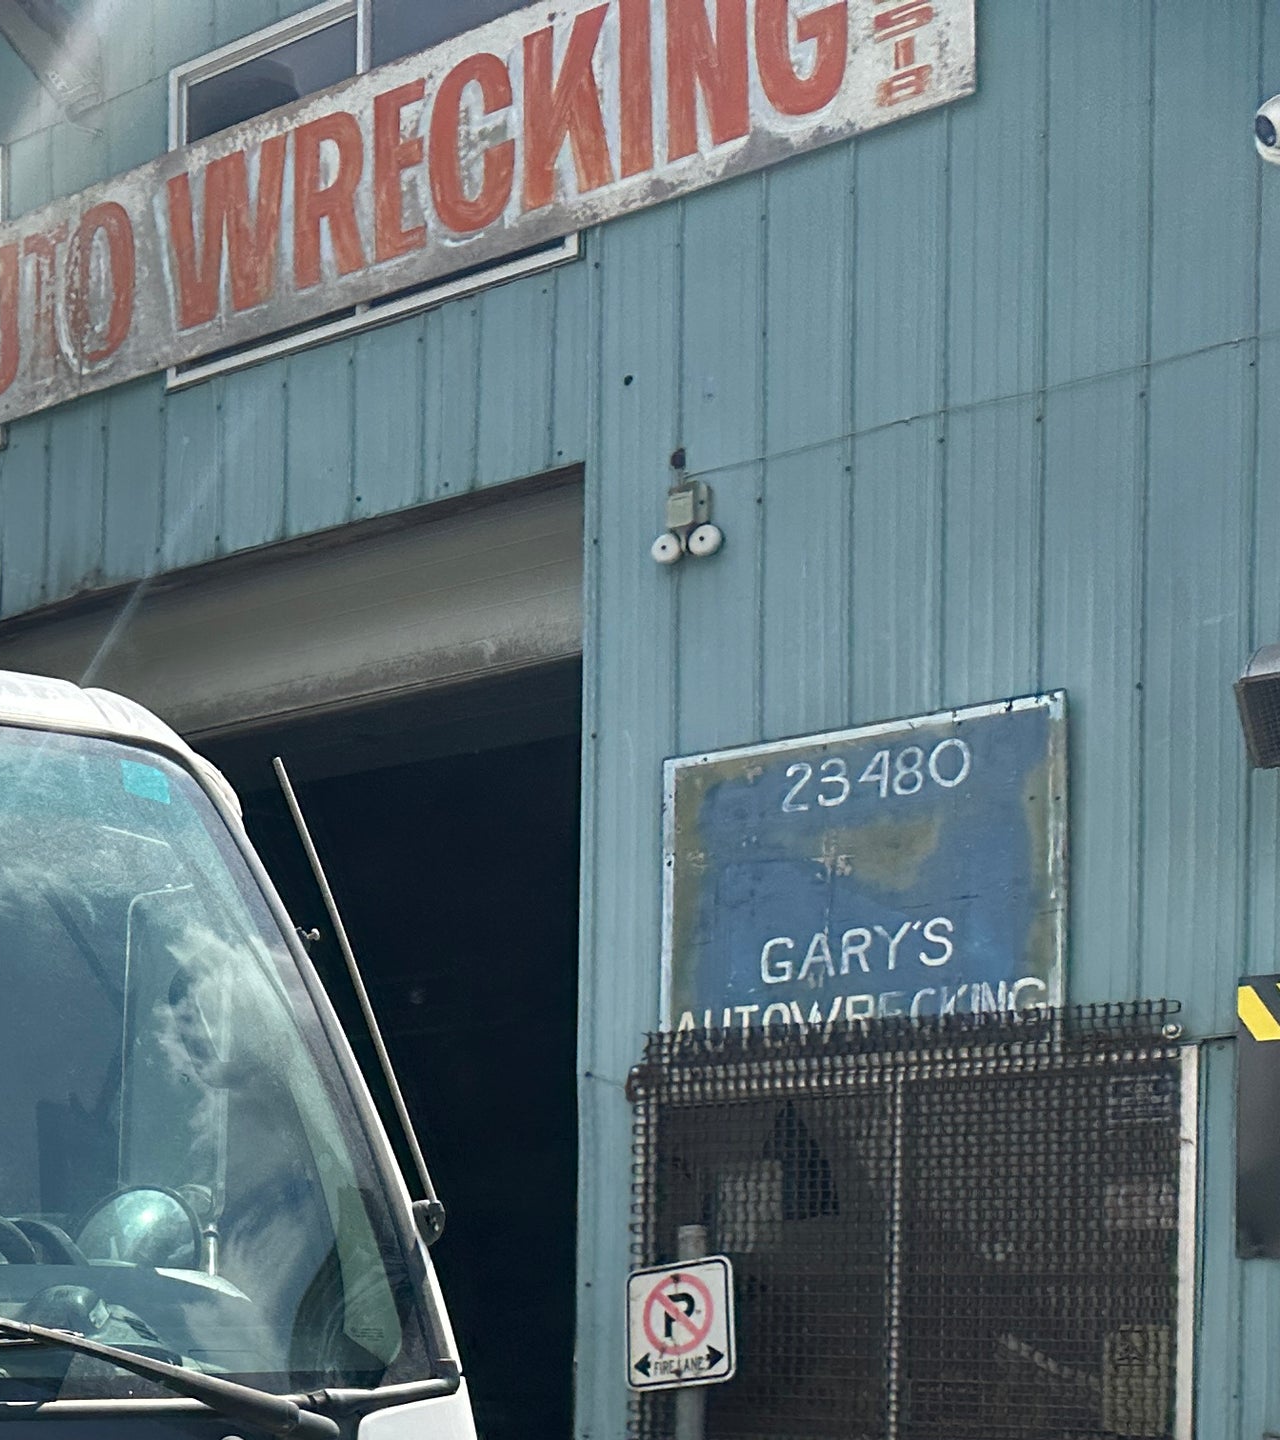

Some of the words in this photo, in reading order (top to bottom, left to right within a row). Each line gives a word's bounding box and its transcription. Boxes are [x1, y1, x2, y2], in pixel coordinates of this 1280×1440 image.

[167, 0, 846, 329] WRECKING
[781, 738, 971, 813] 23480
[760, 917, 954, 985] GARY'S
[653, 1359, 675, 1377] FIRE
